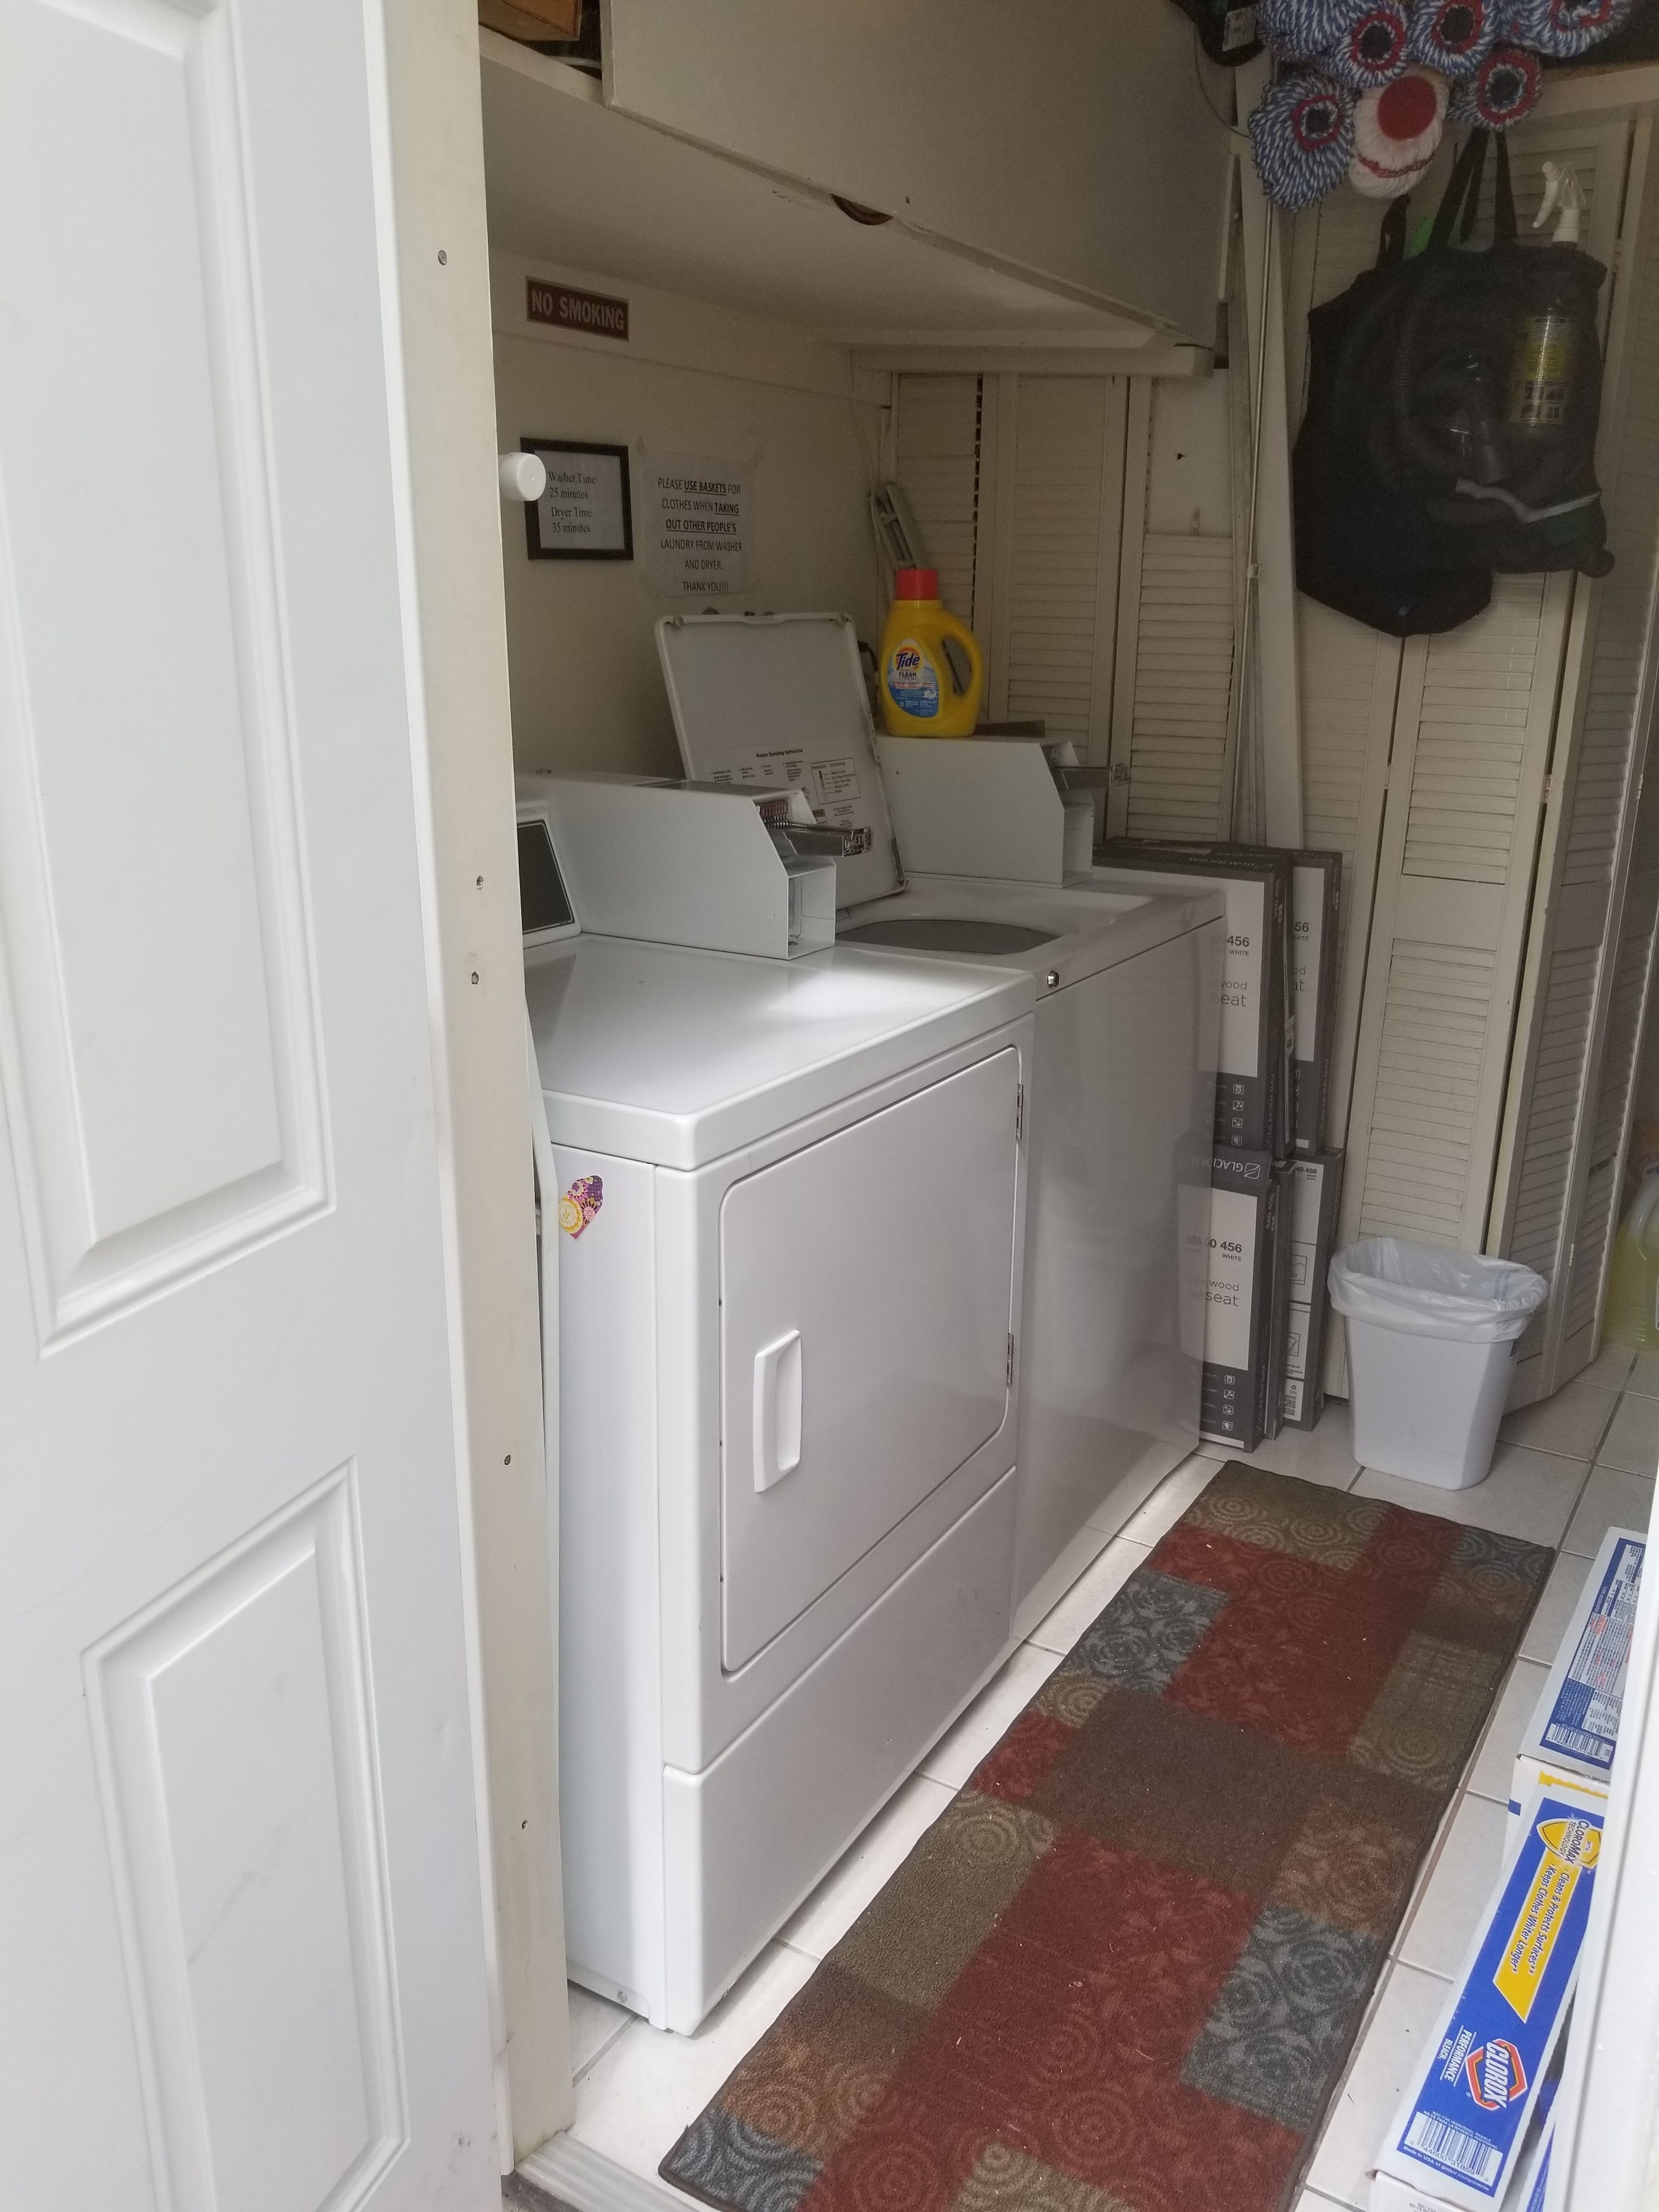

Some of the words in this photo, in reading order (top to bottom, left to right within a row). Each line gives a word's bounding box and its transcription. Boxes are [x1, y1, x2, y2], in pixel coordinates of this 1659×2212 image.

[532, 289, 553, 315] NO
[559, 296, 624, 331] SMOKING
[548, 471, 575, 483] Washer
[577, 474, 596, 484] Time
[550, 487, 558, 498] 25
[560, 488, 589, 499] minutes
[658, 478, 683, 490] PLEASE
[684, 480, 698, 492] USE
[699, 482, 727, 494] BASKETS
[728, 484, 741, 495] FOR
[551, 506, 572, 520] Dryer
[573, 507, 592, 518] Time
[662, 498, 692, 511] CLOTHES
[693, 501, 714, 512] WHEN
[714, 503, 739, 514] TAKING
[552, 522, 560, 533] 35
[562, 522, 591, 533] minutes
[666, 519, 681, 530] OUT
[683, 519, 706, 531] OTHER
[707, 522, 737, 533] PEOPLE'S
[661, 539, 694, 550] LAUNDRY
[695, 540, 714, 551] FROM
[716, 541, 743, 552] WASHER
[685, 560, 699, 570] AND
[700, 560, 724, 570] DRYER.
[682, 581, 706, 592] THANK
[707, 581, 729, 592] YOU!!!
[896, 652, 921, 671] Tide
[1293, 922, 1309, 932] 56
[1227, 935, 1249, 946] 456
[1220, 1241, 1242, 1253] 456
[1222, 1253, 1241, 1261] WHITE
[1210, 1280, 1239, 1291] wood
[1205, 1291, 1238, 1306] seat
[1559, 1821, 1576, 1855] TECHNOLOGY
[1565, 1820, 1590, 1864] CLOROMAX
[1541, 1866, 1556, 1888] Keeps
[1555, 1872, 1569, 1895] Cleans
[1531, 1888, 1548, 1915] Clothes
[1540, 1902, 1558, 1933] Protects
[1521, 1914, 1537, 1941] Whiter
[1444, 2029, 1472, 2082] PERFORMANCE
[1484, 2041, 1510, 2108] CLOROX
[1403, 2145, 1417, 2155] Made
[1423, 2156, 1435, 2164] USA
[1441, 2165, 1457, 2176] global
[1457, 2172, 1490, 2191] components
[1423, 2146, 1448, 2161] 44600
[1450, 2160, 1475, 2175] 31859
